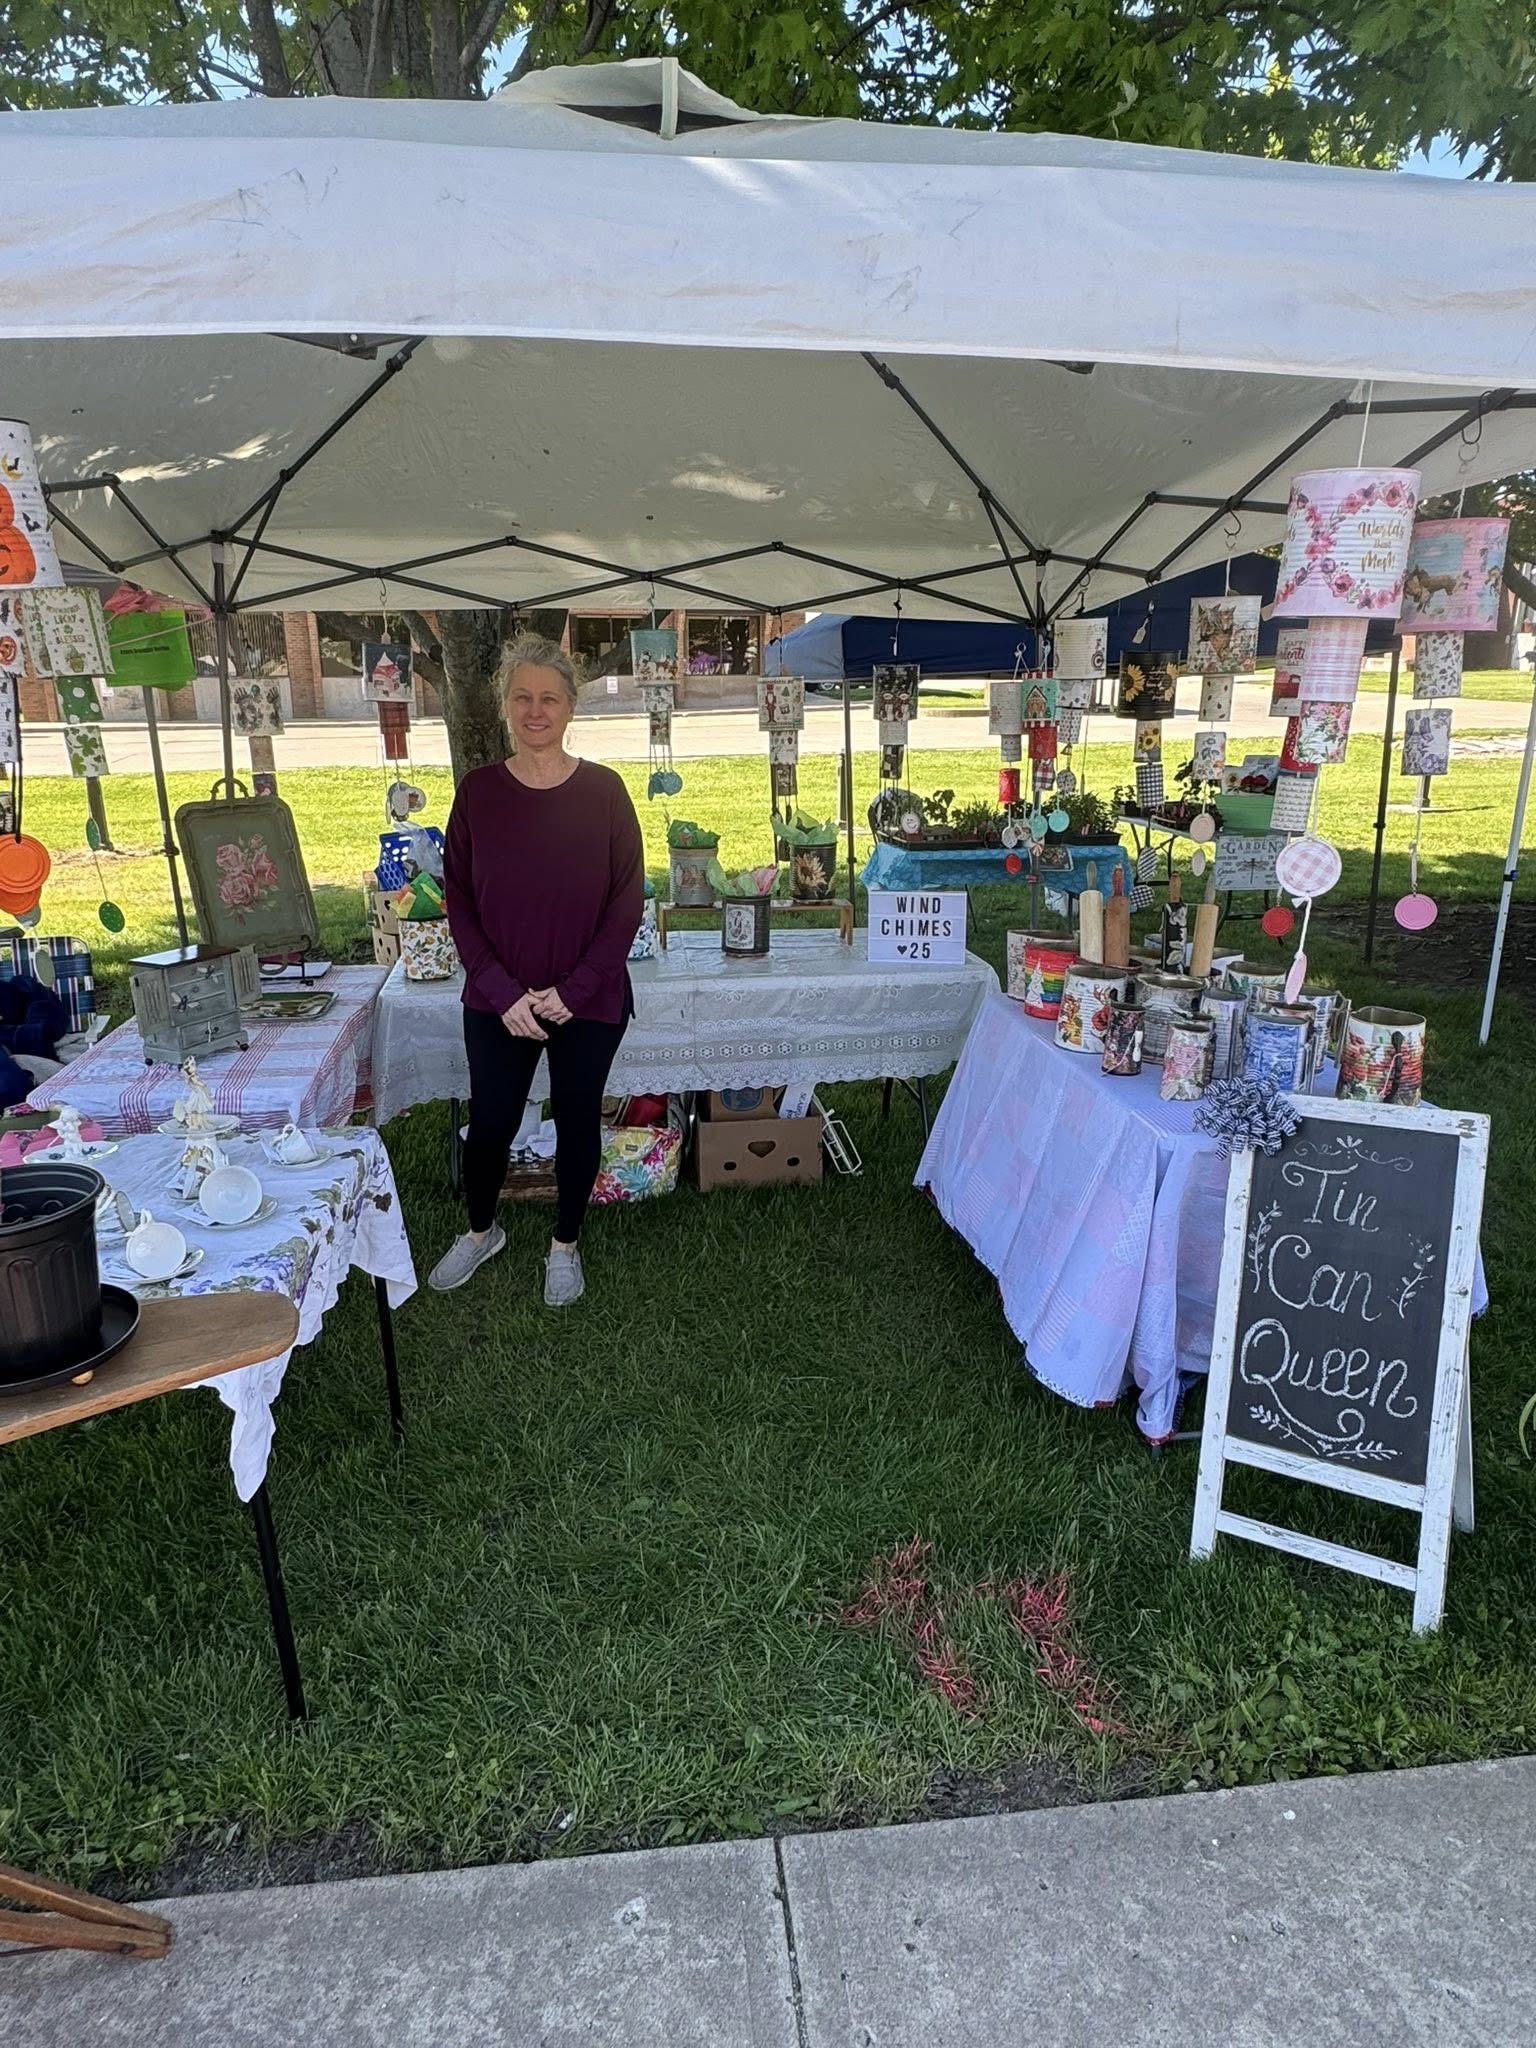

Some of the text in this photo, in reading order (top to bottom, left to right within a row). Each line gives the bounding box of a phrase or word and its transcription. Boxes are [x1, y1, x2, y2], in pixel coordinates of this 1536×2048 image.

[1226, 841, 1278, 855] GARDEN
[896, 896, 942, 915] WIND
[881, 918, 952, 938] CHIMES
[909, 941, 931, 960] 25
[1282, 1161, 1380, 1233] Tin
[1268, 1234, 1383, 1322] Can
[1239, 1317, 1418, 1443] Queen
